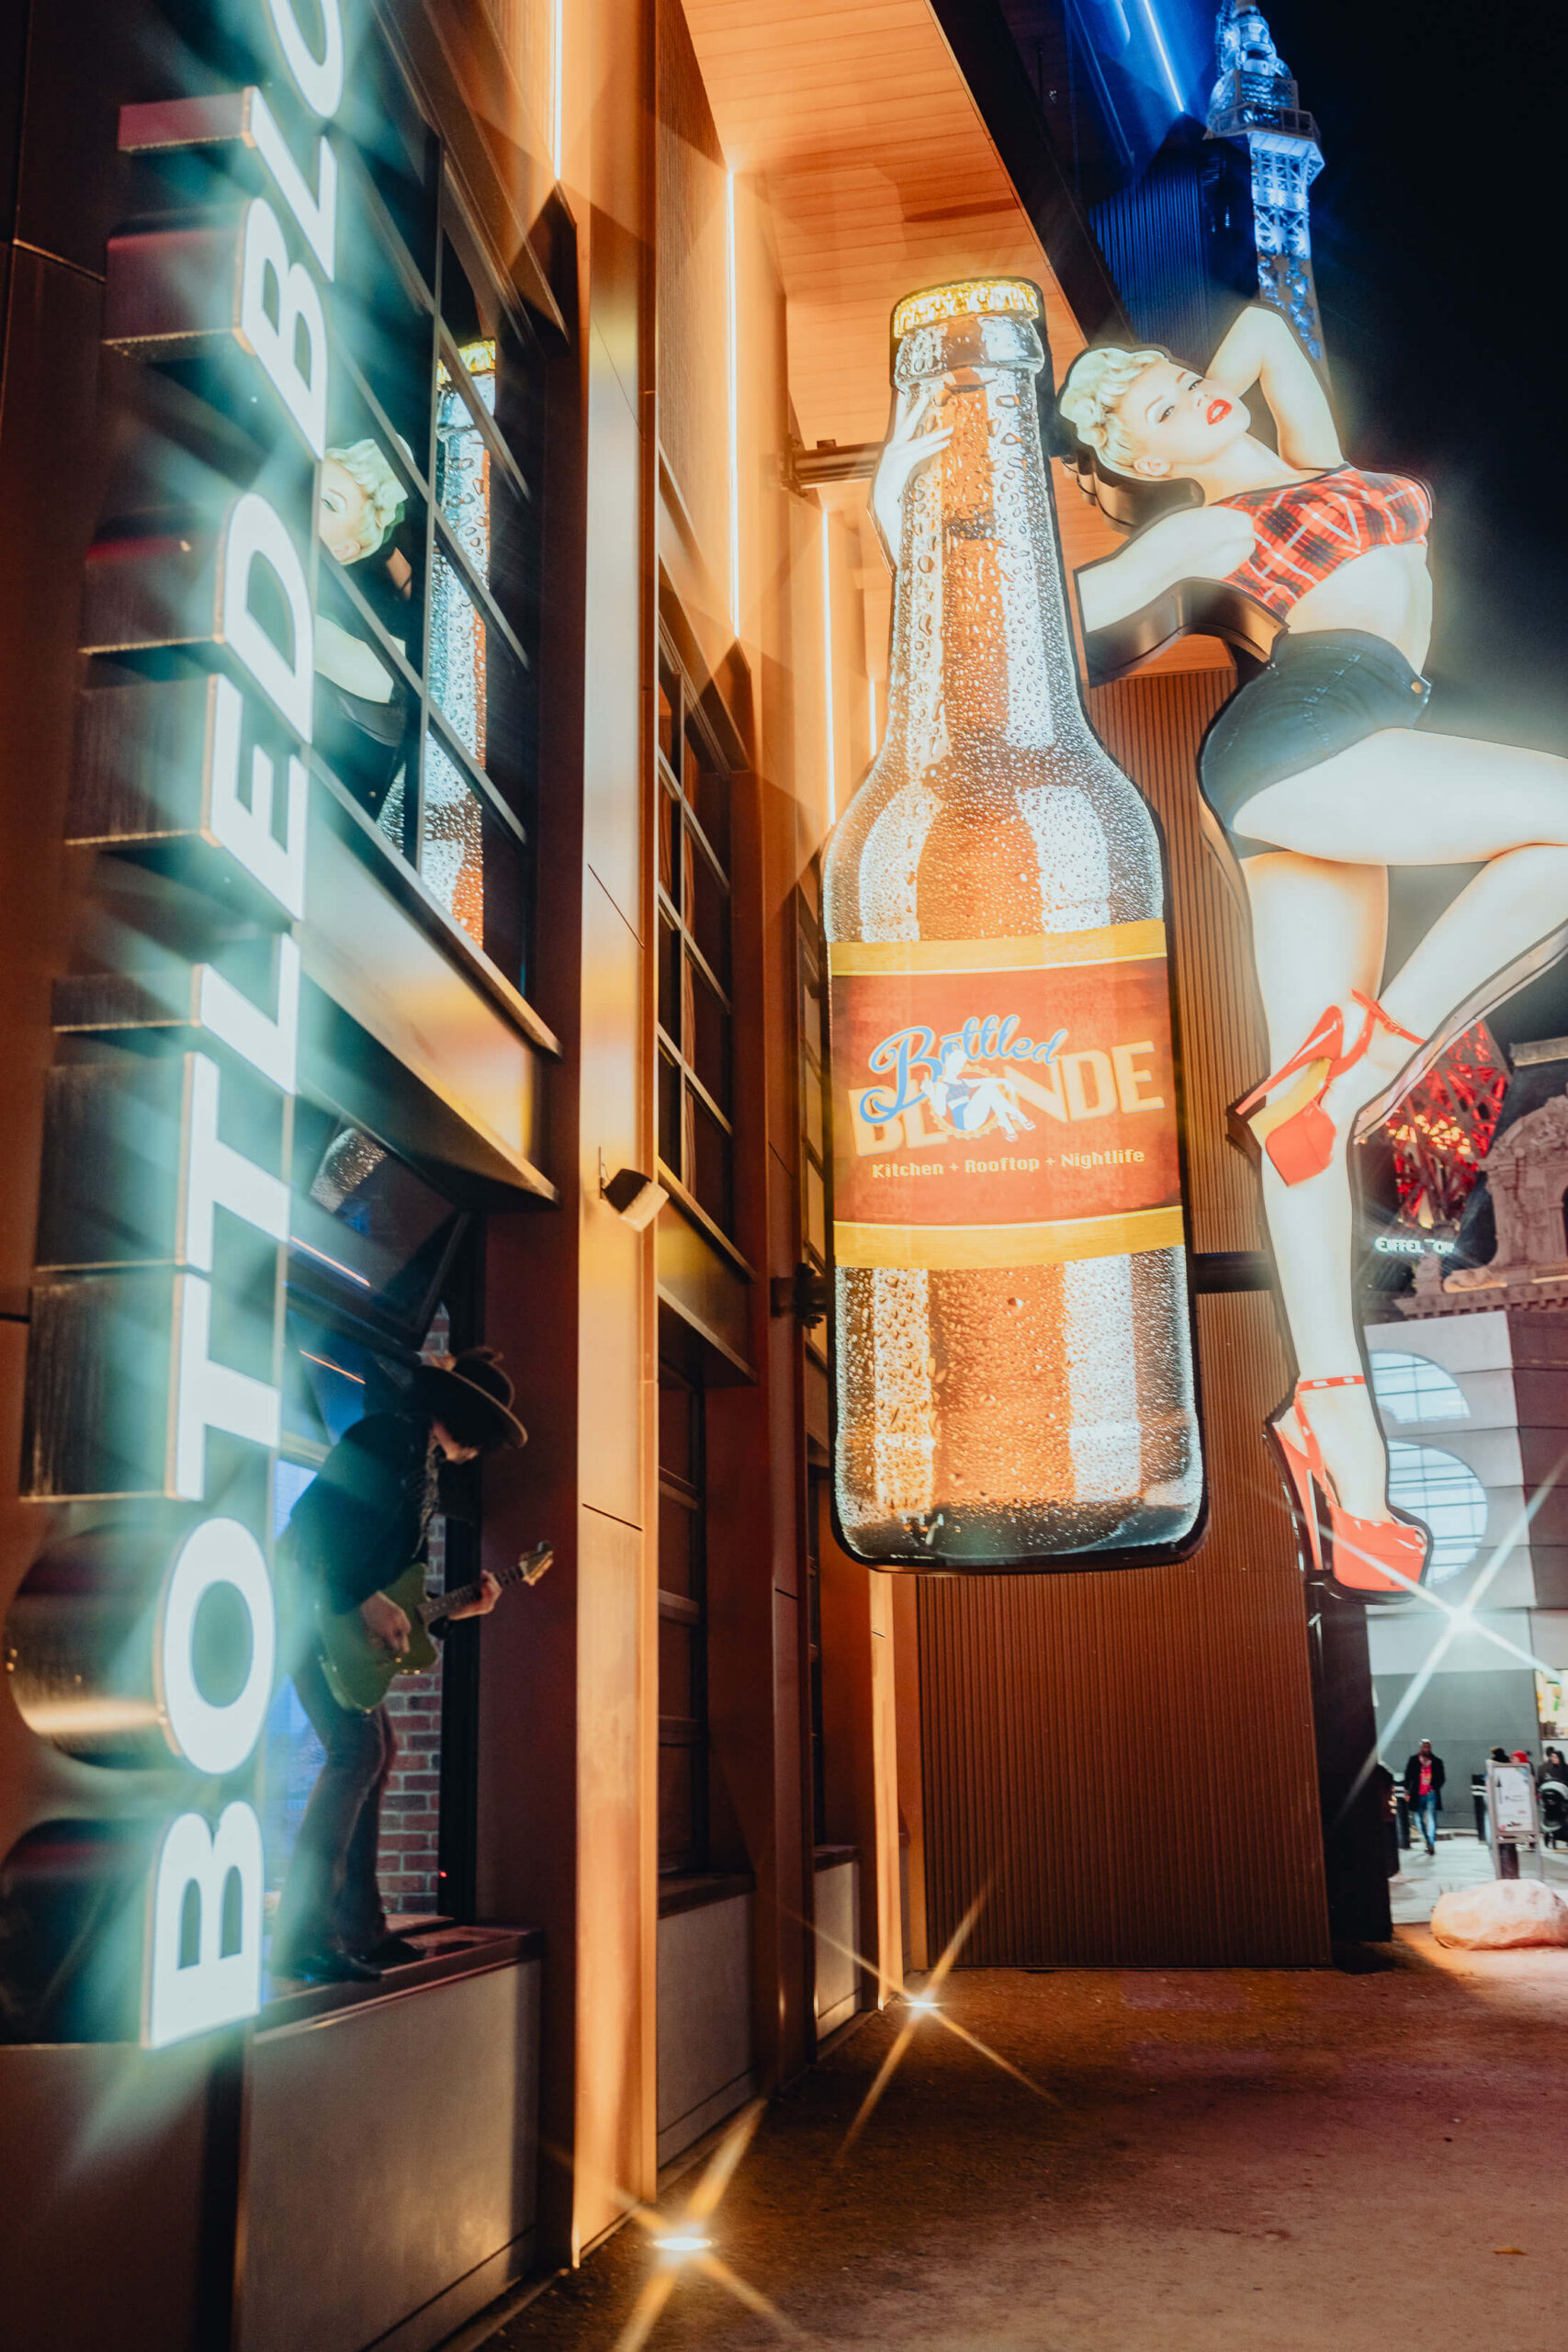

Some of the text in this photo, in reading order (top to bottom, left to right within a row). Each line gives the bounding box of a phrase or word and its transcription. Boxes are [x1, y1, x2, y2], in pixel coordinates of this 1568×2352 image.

[860, 1014, 1068, 1124] Bottled
[872, 1162, 944, 1178] Kitchen
[964, 1157, 1040, 1173] Rooftop
[1061, 1148, 1145, 1170] Nightlife
[143, 492, 316, 2049] BOTTLED
